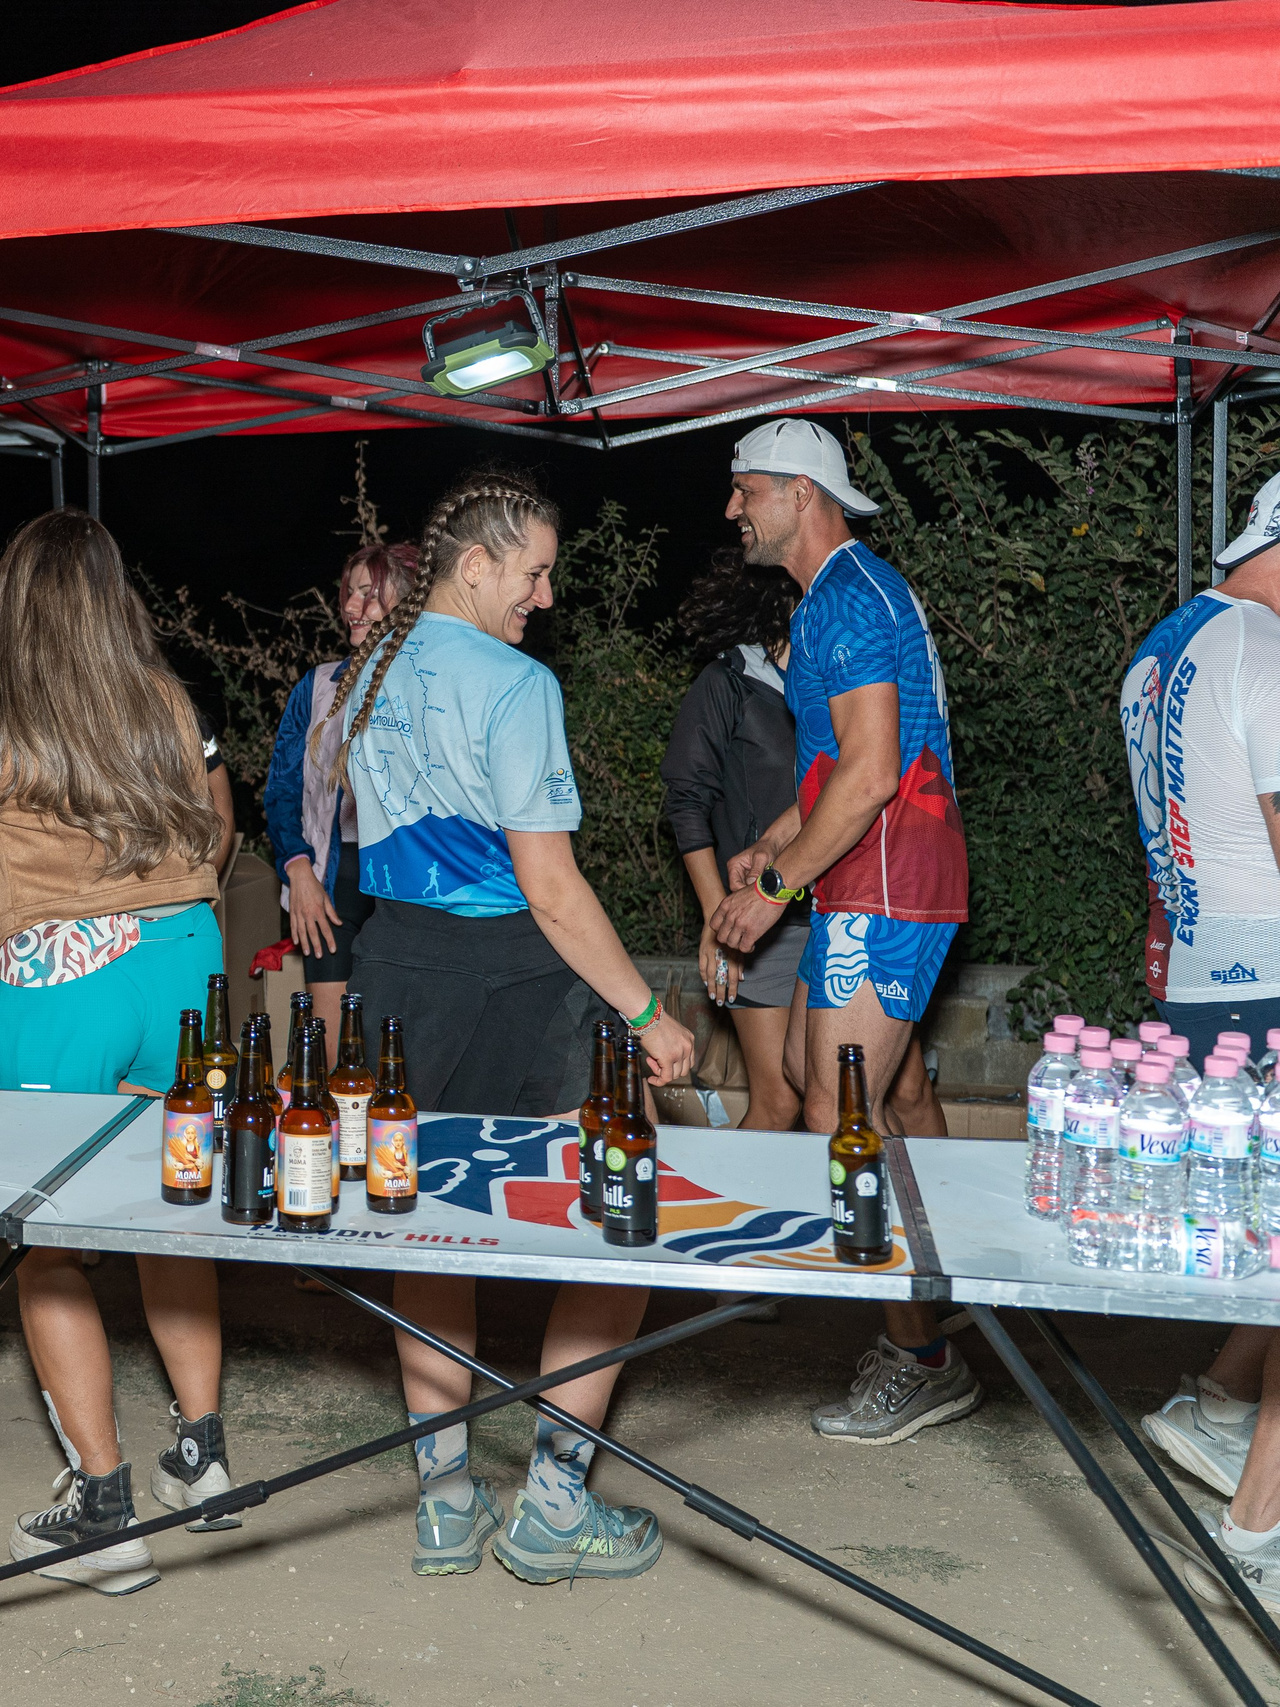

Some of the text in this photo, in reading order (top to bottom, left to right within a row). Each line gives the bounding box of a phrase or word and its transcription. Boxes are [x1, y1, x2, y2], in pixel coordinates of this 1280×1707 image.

[1166, 656, 1200, 947] EVERY STEP MATTERS
[1139, 1133, 1177, 1155] Vesa
[175, 1171, 202, 1180] MOMA
[384, 1179, 410, 1188] MOMA
[603, 1183, 633, 1208] hills
[832, 1199, 855, 1223] ills
[275, 1233, 369, 1243] MARKOVO
[403, 1233, 501, 1247] HILLS
[1195, 1226, 1217, 1266] Vesa
